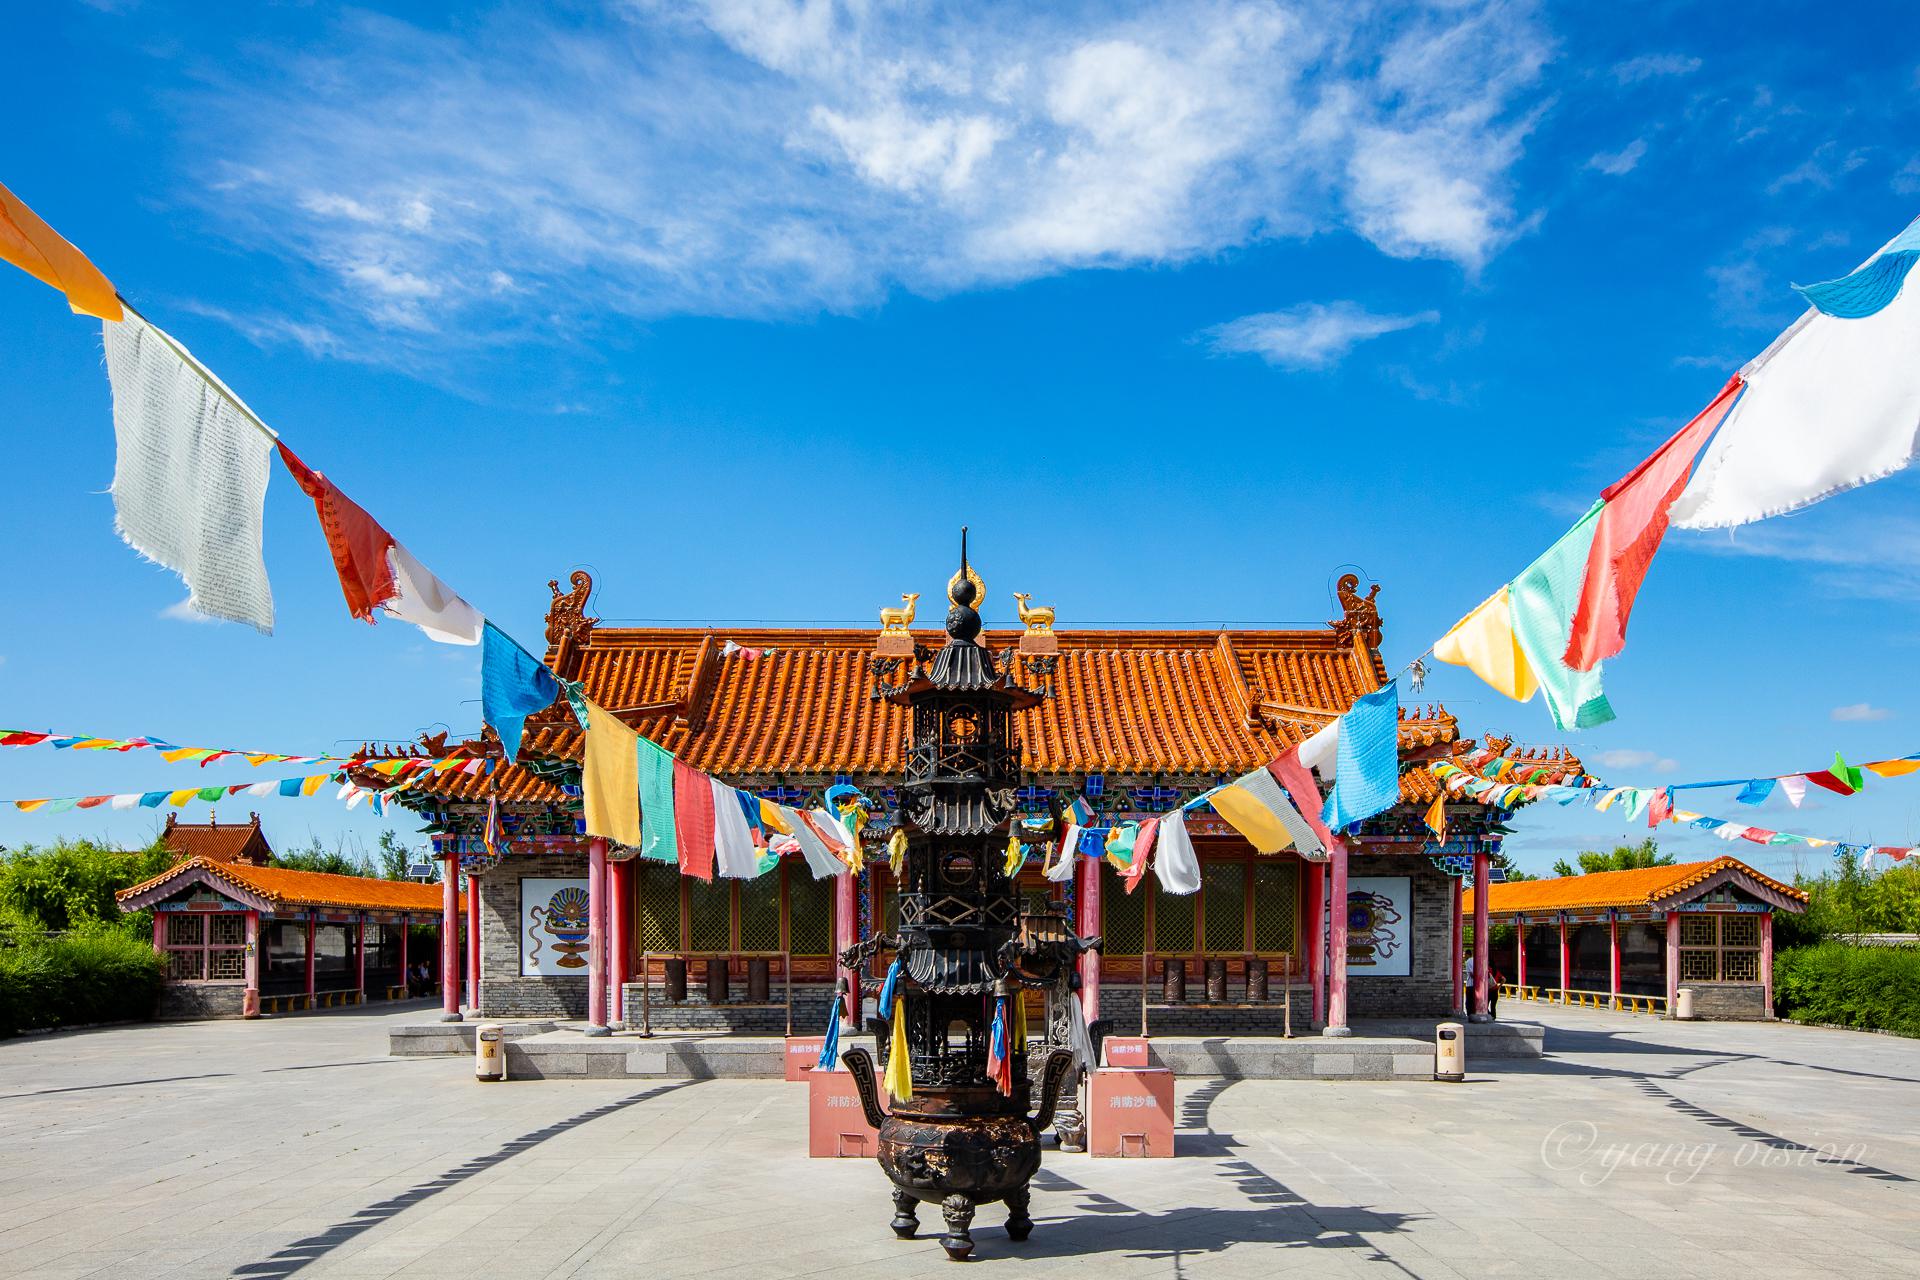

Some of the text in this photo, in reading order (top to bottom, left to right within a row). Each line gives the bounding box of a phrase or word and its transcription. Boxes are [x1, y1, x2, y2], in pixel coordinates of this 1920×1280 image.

[826, 1095, 861, 1108] 消防沙
[1110, 1095, 1157, 1108] 消防沙箱
